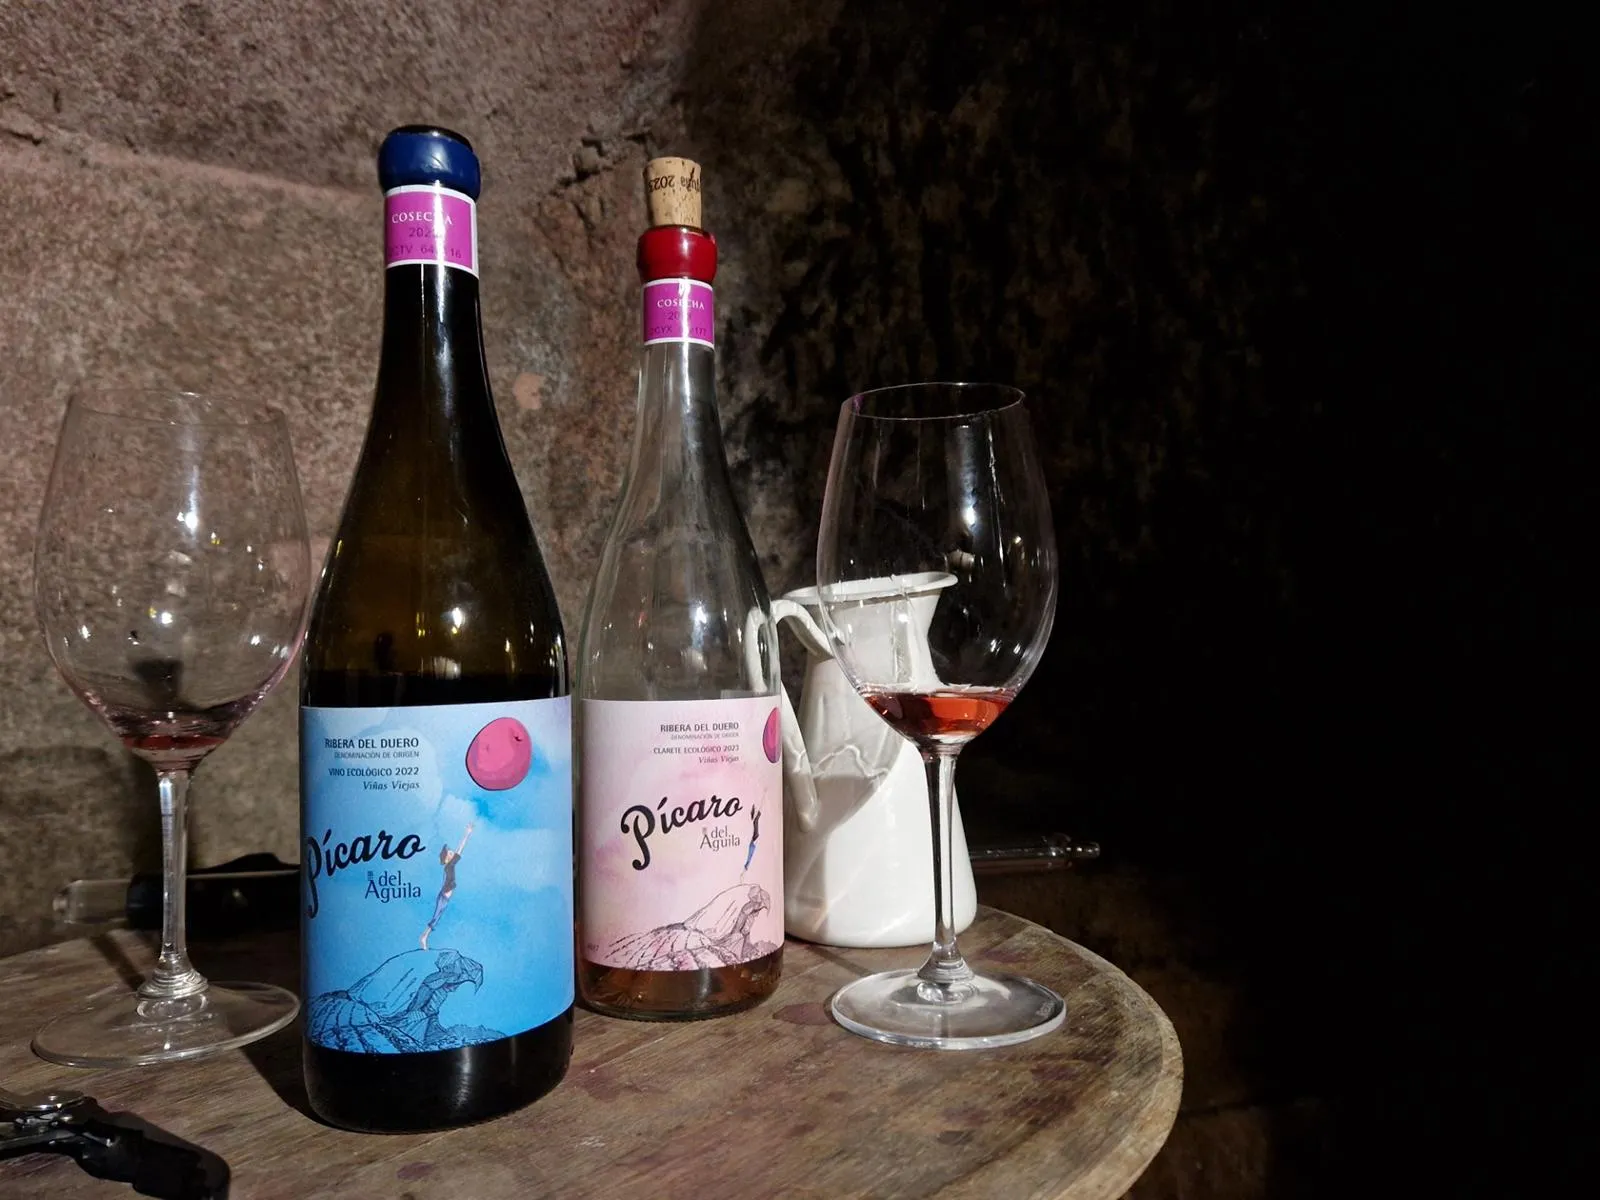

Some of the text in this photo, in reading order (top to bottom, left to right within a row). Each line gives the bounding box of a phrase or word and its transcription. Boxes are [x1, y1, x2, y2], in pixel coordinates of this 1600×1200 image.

[392, 211, 453, 225] COSECA
[657, 298, 705, 310] COSCHA
[660, 722, 739, 733] RIBERA DEL DUERO
[324, 737, 419, 749] RIBERA DEL DUERO
[683, 745, 722, 754] ECOLÓGICO
[723, 744, 740, 752] 2023
[328, 766, 419, 776] VINO ECOLÓGICO 2022
[363, 781, 420, 791] Viñas Viejas
[620, 795, 743, 871] Pícaro
[711, 825, 728, 838] del
[378, 870, 402, 886] del
